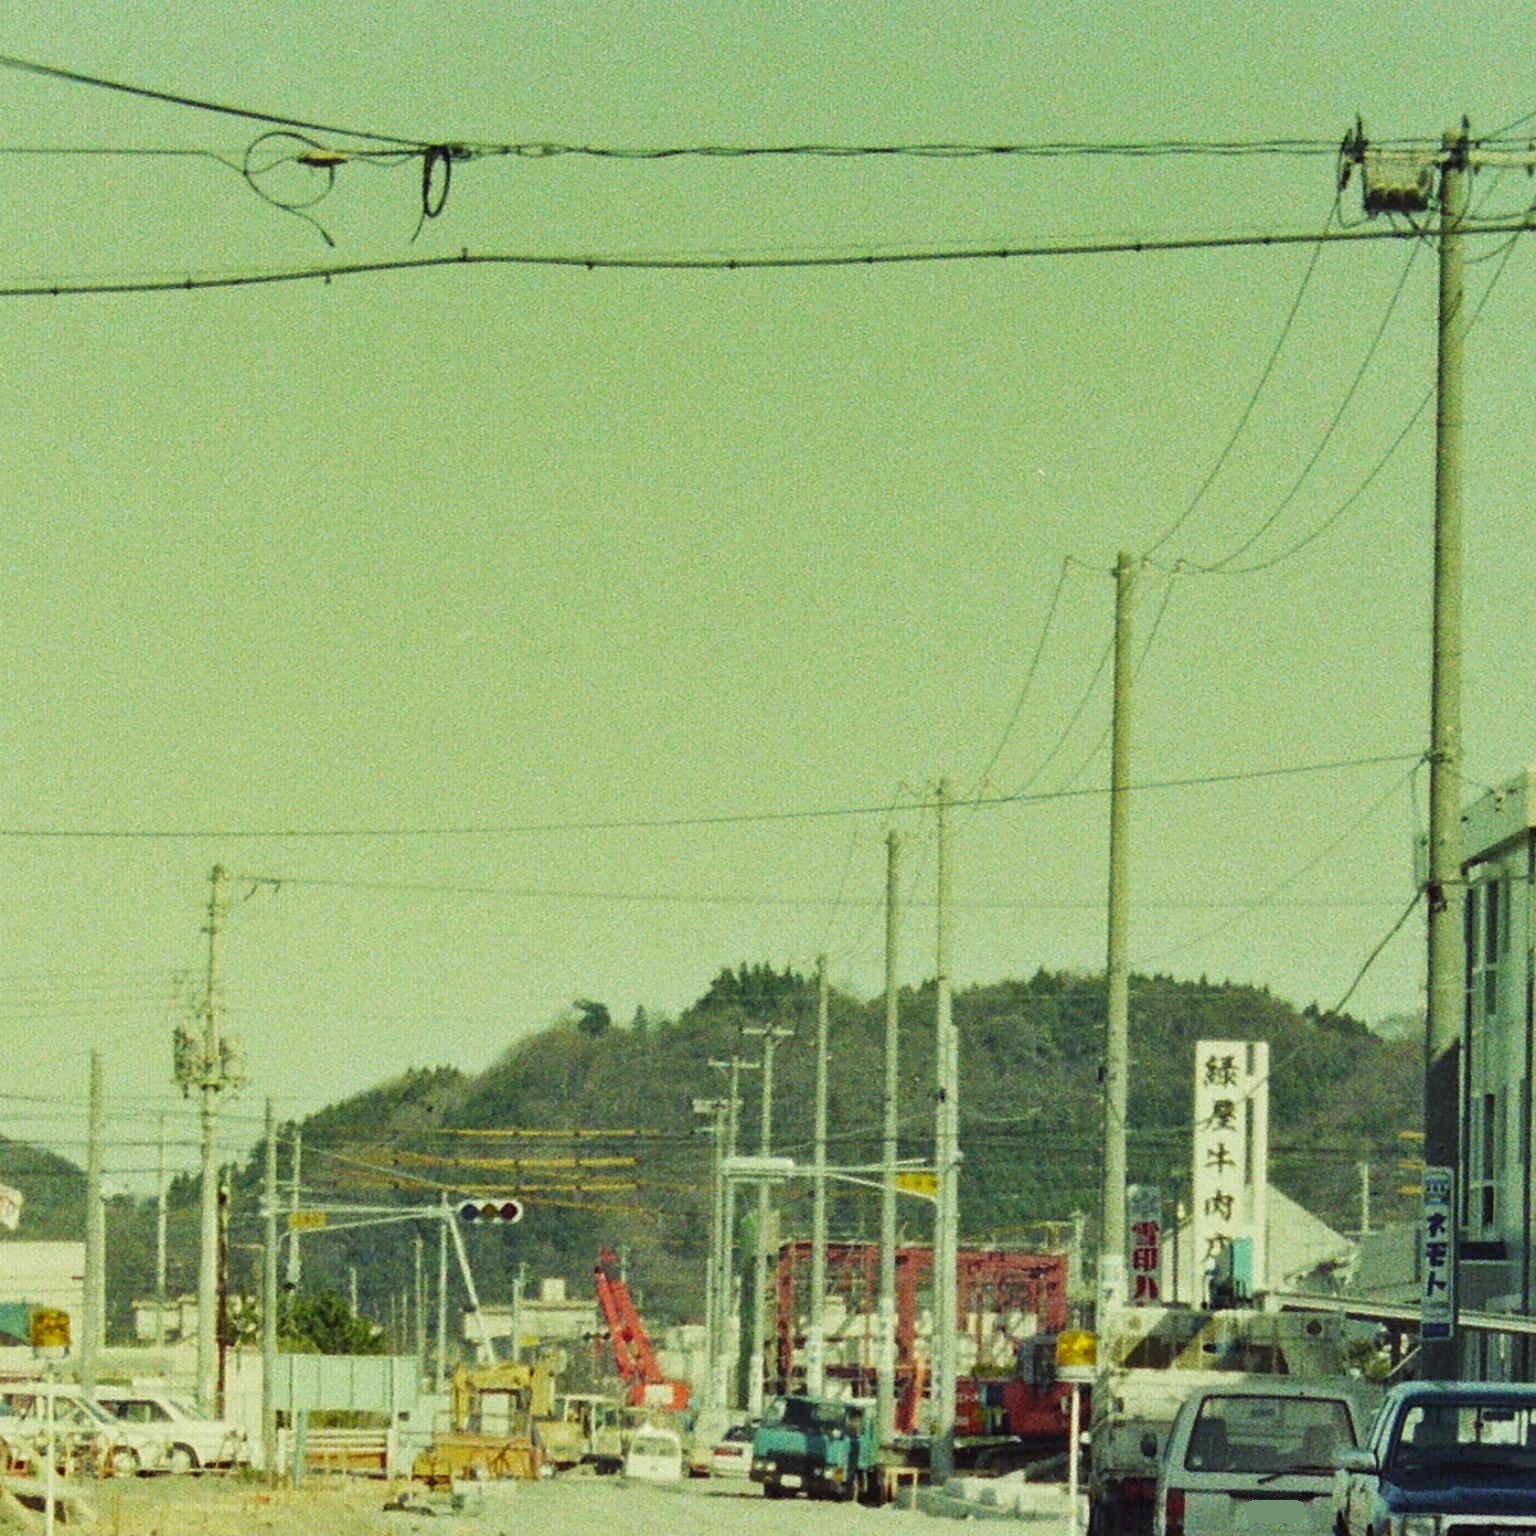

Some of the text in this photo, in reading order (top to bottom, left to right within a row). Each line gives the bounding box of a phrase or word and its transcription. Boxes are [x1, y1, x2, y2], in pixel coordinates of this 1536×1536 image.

[1131, 1221, 1160, 1308] 雪印ハ
[1426, 1212, 1447, 1297] ネモト
